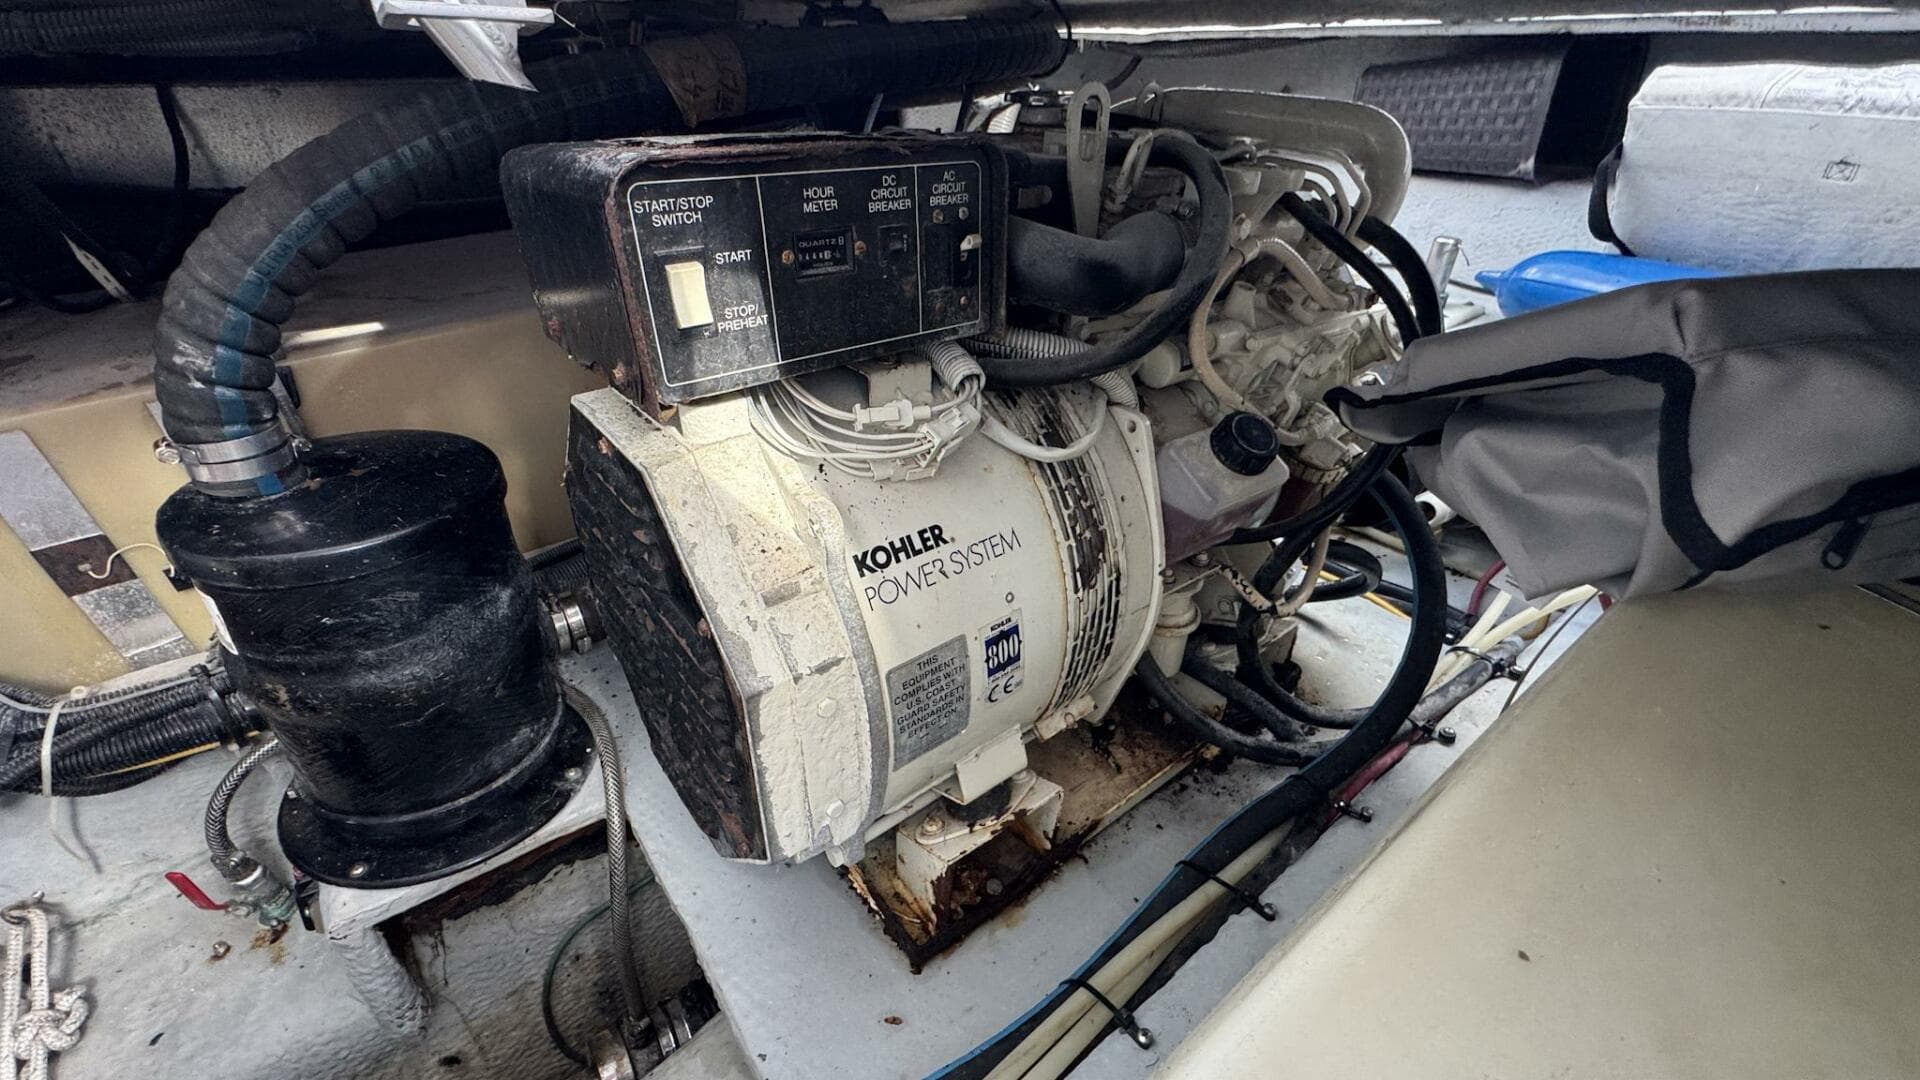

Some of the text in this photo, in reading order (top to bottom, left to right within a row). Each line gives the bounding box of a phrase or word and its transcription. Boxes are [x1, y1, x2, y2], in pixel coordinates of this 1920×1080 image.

[882, 175, 897, 187] DC
[943, 171, 956, 182] AC
[803, 186, 835, 199] HOUR
[870, 185, 908, 200] CIRCUIT
[932, 181, 967, 194] CIRCUIT
[633, 195, 714, 215] START/STOP
[803, 200, 839, 214] METER
[868, 199, 912, 214] BREAKER
[929, 193, 969, 207] BREAKER
[652, 211, 702, 228] SWITCH
[798, 238, 838, 248] QUARTZ
[715, 250, 752, 265] START
[724, 303, 759, 319] STOP/
[718, 315, 769, 333] PREHEAT
[864, 527, 1023, 611] POWER SYSTEM
[987, 633, 1019, 669] 800
[917, 654, 939, 671] THIS
[902, 656, 956, 690] EQUIPMENT
[894, 675, 941, 705] COMPLIES
[943, 663, 966, 680] WITH
[906, 678, 956, 710] U.S. COAST
[897, 683, 967, 726] GUARD SAFETY
[899, 694, 965, 734] STANDARDS IN
[908, 715, 942, 739] EFFECT
